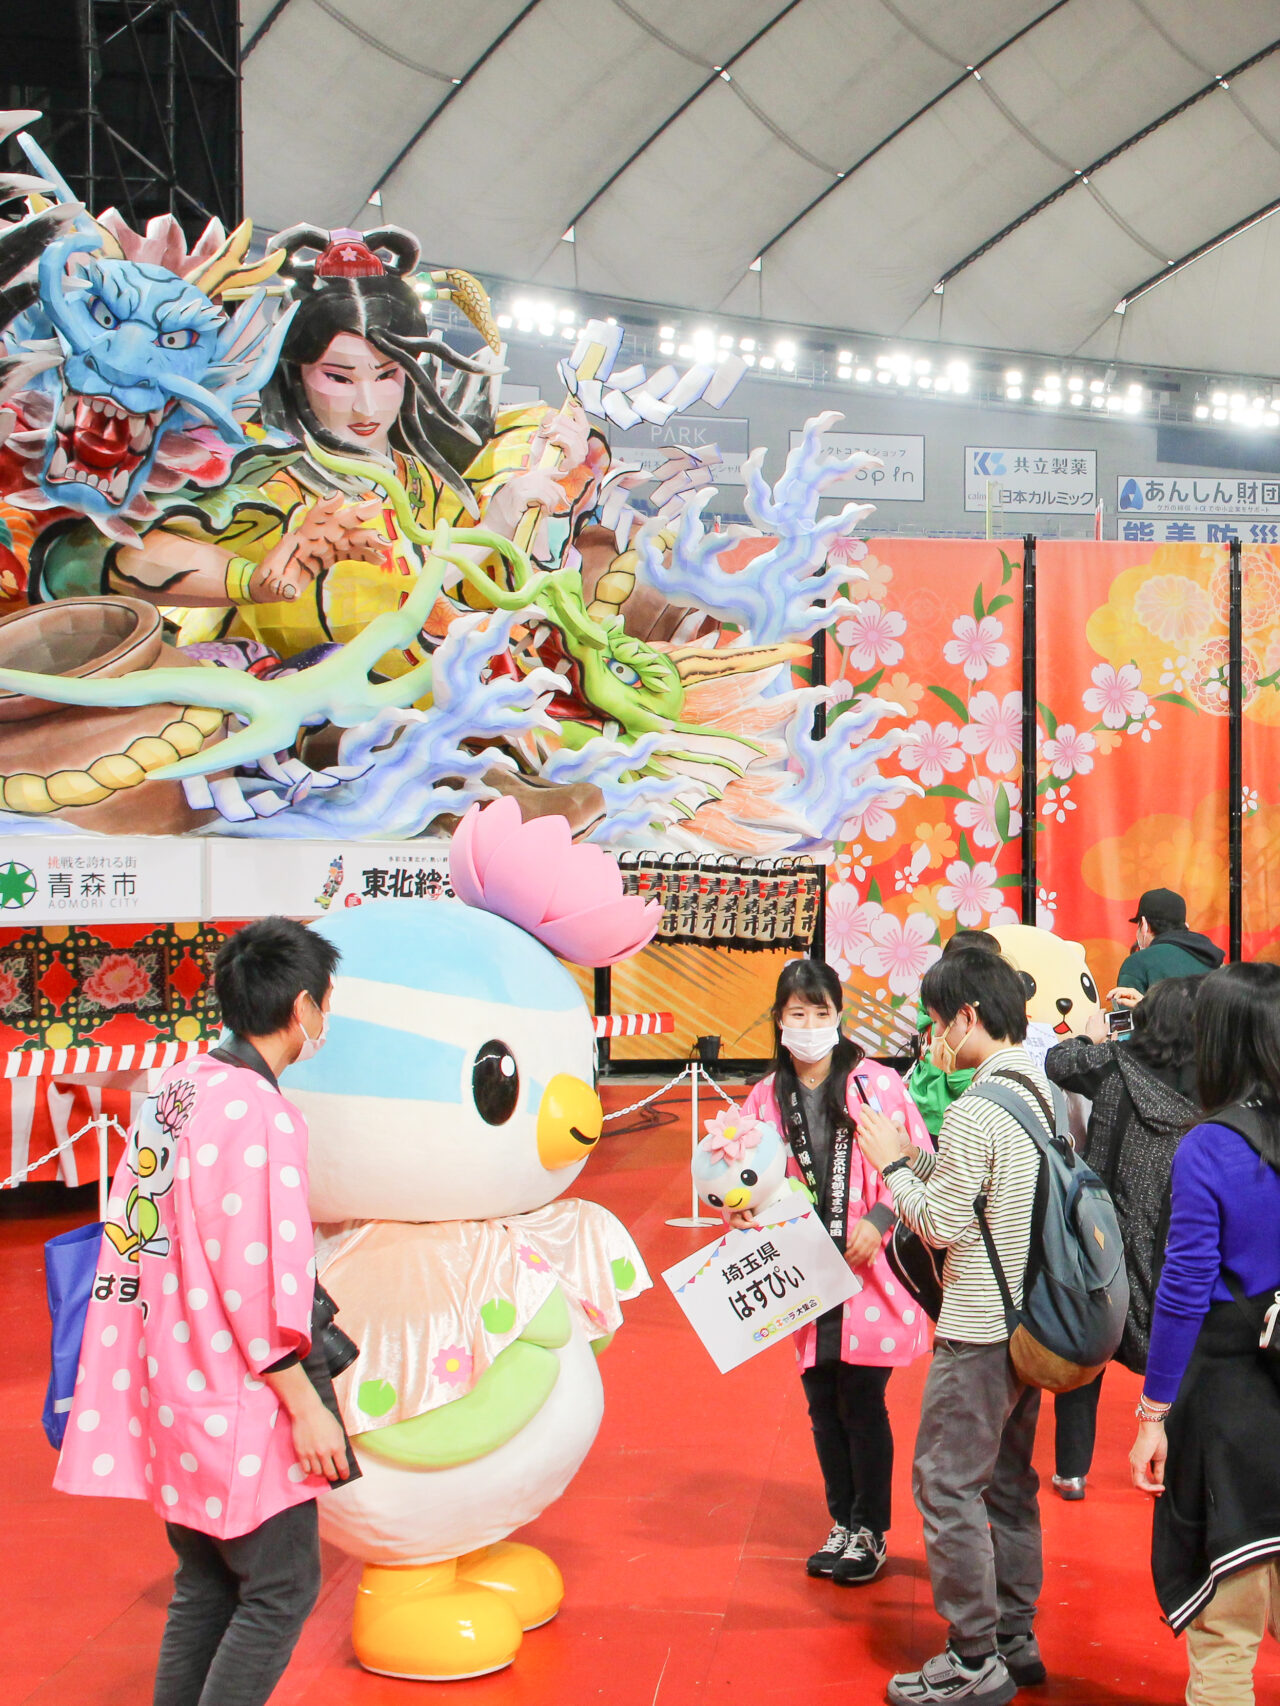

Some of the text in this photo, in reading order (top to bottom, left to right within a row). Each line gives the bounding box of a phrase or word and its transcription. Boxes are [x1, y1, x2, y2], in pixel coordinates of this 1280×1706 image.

[650, 425, 708, 445] PARK
[1013, 456, 1088, 476] 共立製薬
[999, 489, 1094, 507] 日本カルミック
[48, 856, 137, 869] 挑戦を誇れる街
[48, 872, 138, 898] 青森市
[48, 898, 140, 909] AOMORI CITY
[721, 1241, 781, 1285] 埼玉県
[728, 1264, 806, 1322] はすぴい
